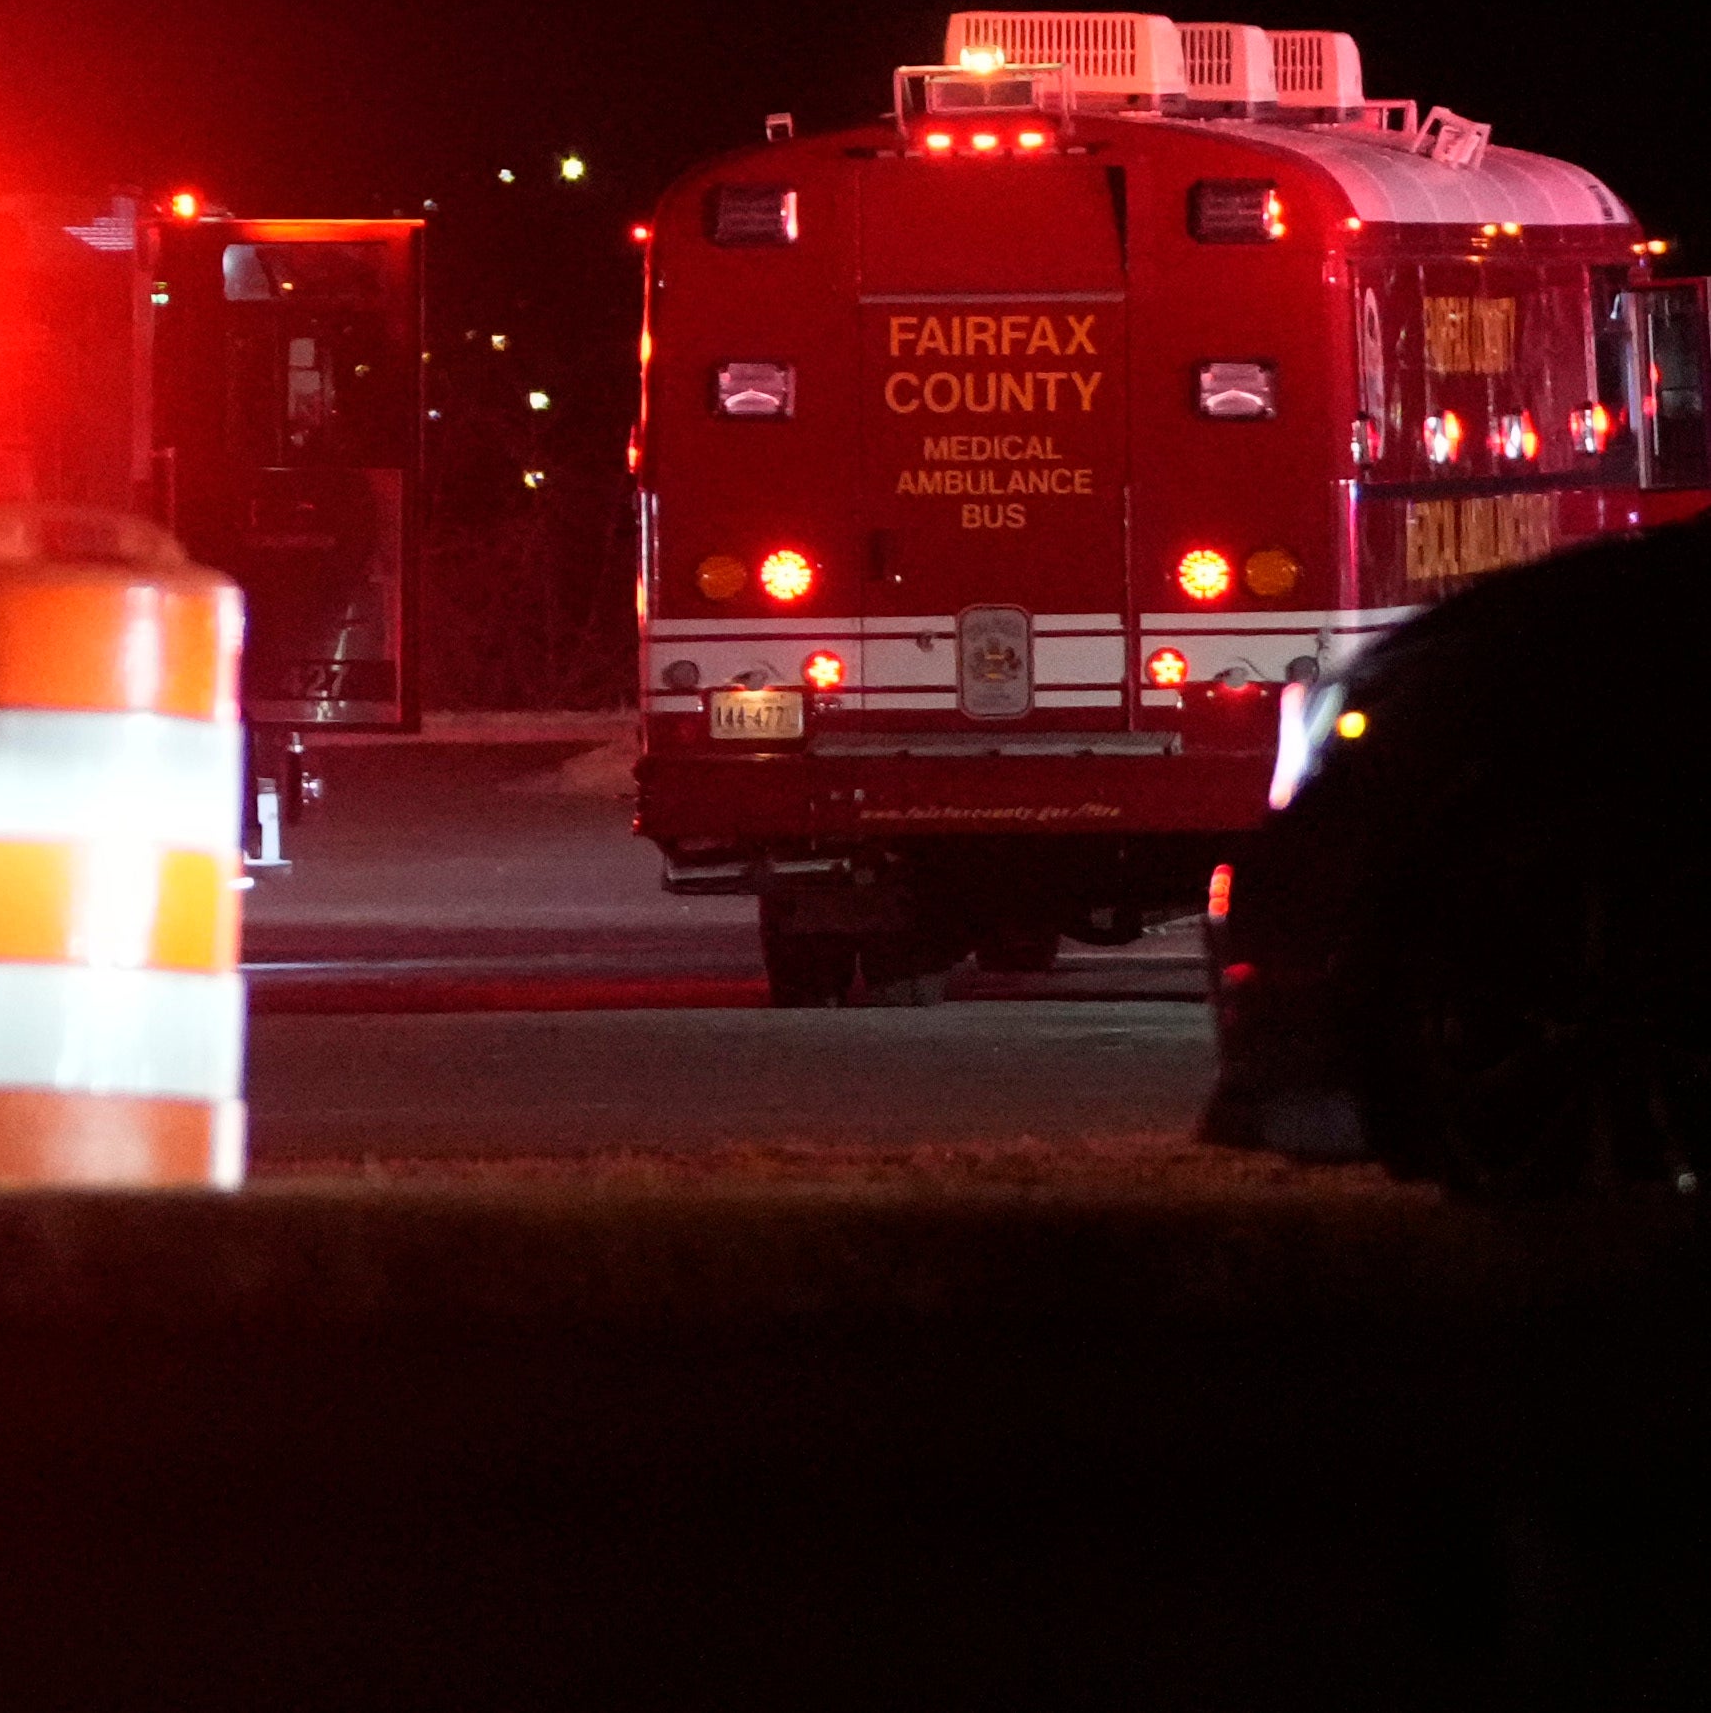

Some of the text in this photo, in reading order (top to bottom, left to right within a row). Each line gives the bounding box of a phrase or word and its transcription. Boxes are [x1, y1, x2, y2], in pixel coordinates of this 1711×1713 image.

[889, 315, 1098, 356] FAIRFAX
[884, 371, 1103, 414] COUNTY
[923, 435, 1063, 461] MEDICAL
[895, 468, 1094, 495] AMBULANCE
[961, 503, 1027, 529] BUS
